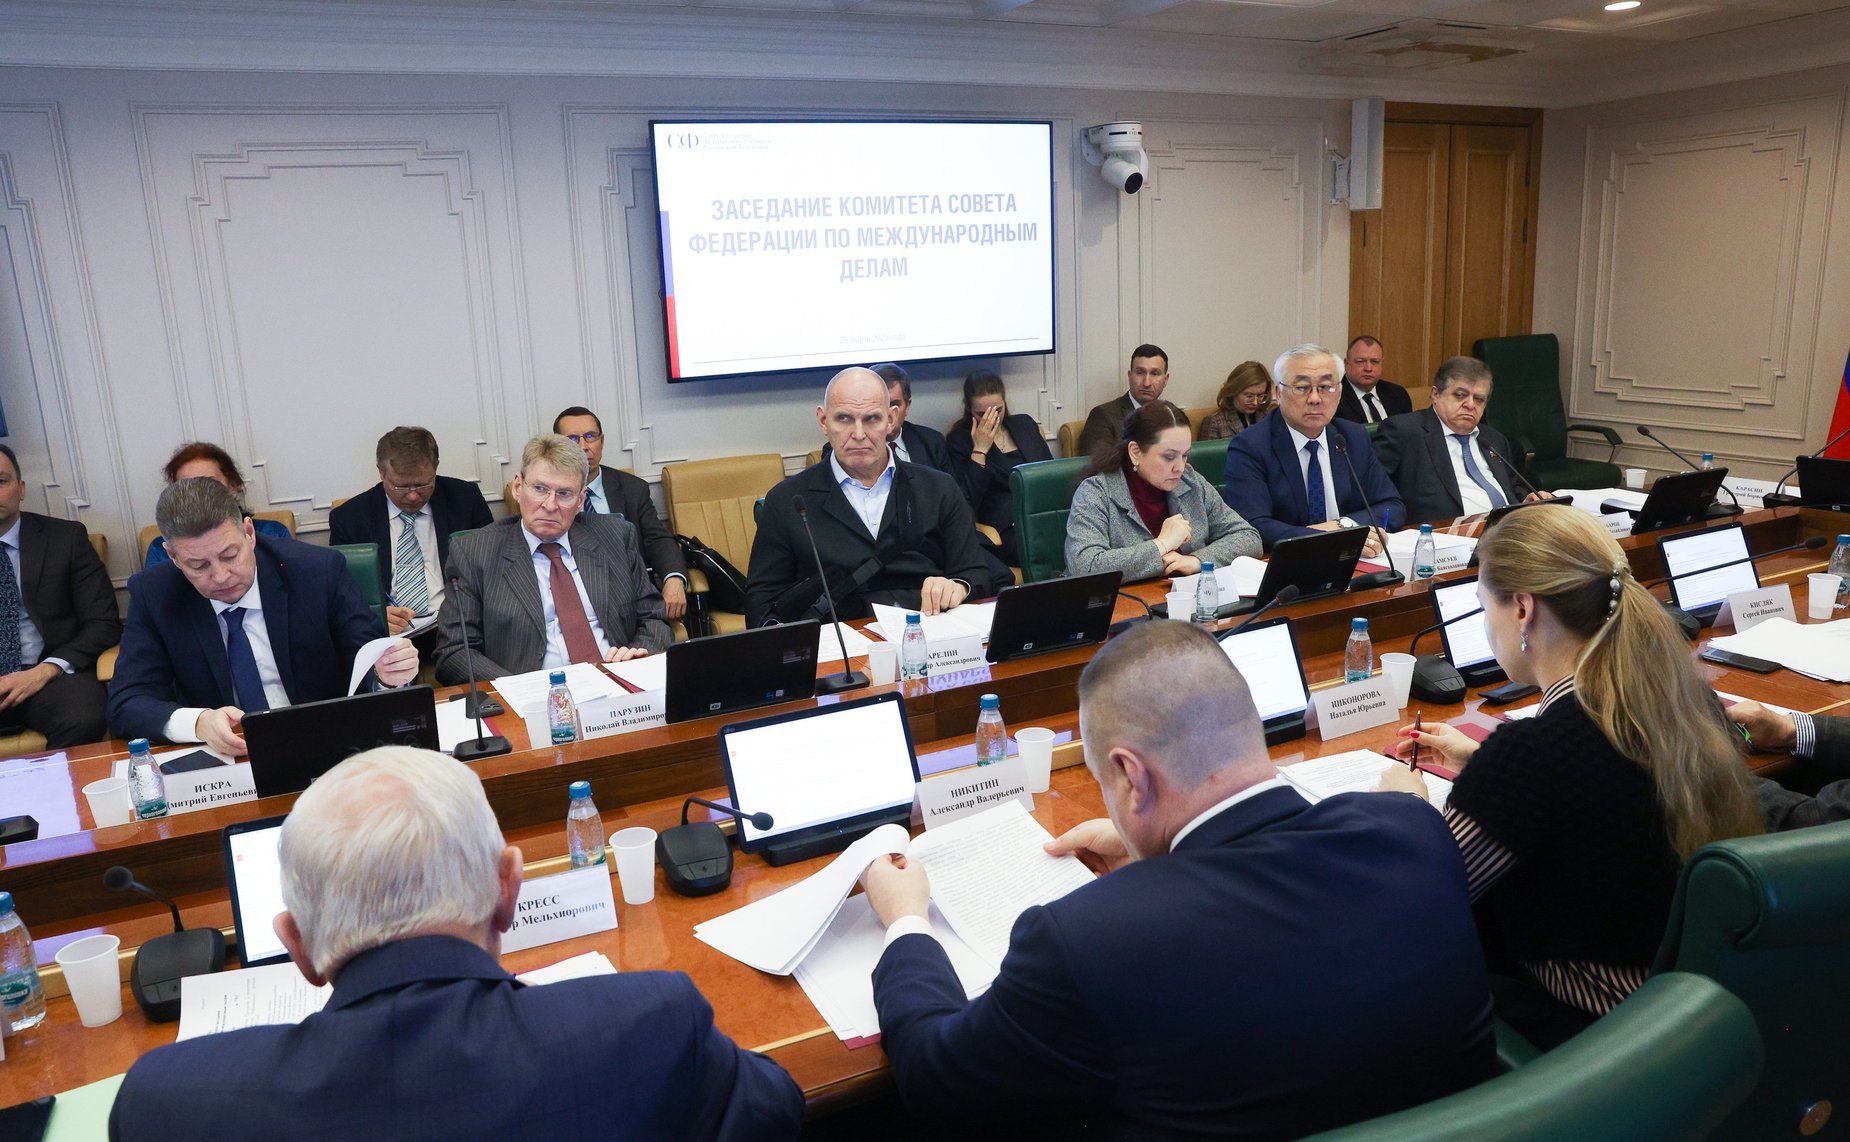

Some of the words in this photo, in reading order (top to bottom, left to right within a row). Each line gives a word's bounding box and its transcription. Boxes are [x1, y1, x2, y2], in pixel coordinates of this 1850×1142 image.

[712, 197, 833, 222] ЗАСЕДАНИЕ
[839, 195, 943, 217] КОМИТЕТА
[949, 193, 1017, 214] СОВЕТА
[688, 229, 817, 256] ФЕДЕРАЦИИ
[825, 228, 850, 249] ПО
[857, 222, 1037, 248] МЕЖДУНАРОДНЫМ
[840, 257, 908, 282] ДЕЛАМ
[1736, 485, 1763, 493] КАРАСИН
[1434, 556, 1457, 564] АМСУЕВ
[1750, 598, 1773, 608] КИСЛЯК
[1742, 610, 1760, 619] Сергей
[1760, 606, 1785, 616] Иванович
[927, 649, 958, 660] АРЕЛИН
[934, 656, 981, 668] Александрович
[1331, 690, 1381, 708] НИКОНОРОВА
[609, 704, 652, 718] ПАРУЗИН
[1329, 709, 1357, 720] Наталья
[1357, 700, 1386, 713] Юрьевна
[585, 721, 620, 733] Николай
[621, 713, 665, 727] Владимиро
[194, 780, 232, 793] ИСКРА
[950, 778, 999, 798] НИКИТИН
[929, 799, 975, 817] Александр
[976, 785, 1025, 804] Валерьевич
[518, 894, 560, 913] КРЕСС
[522, 901, 605, 927] Мельхиорович
